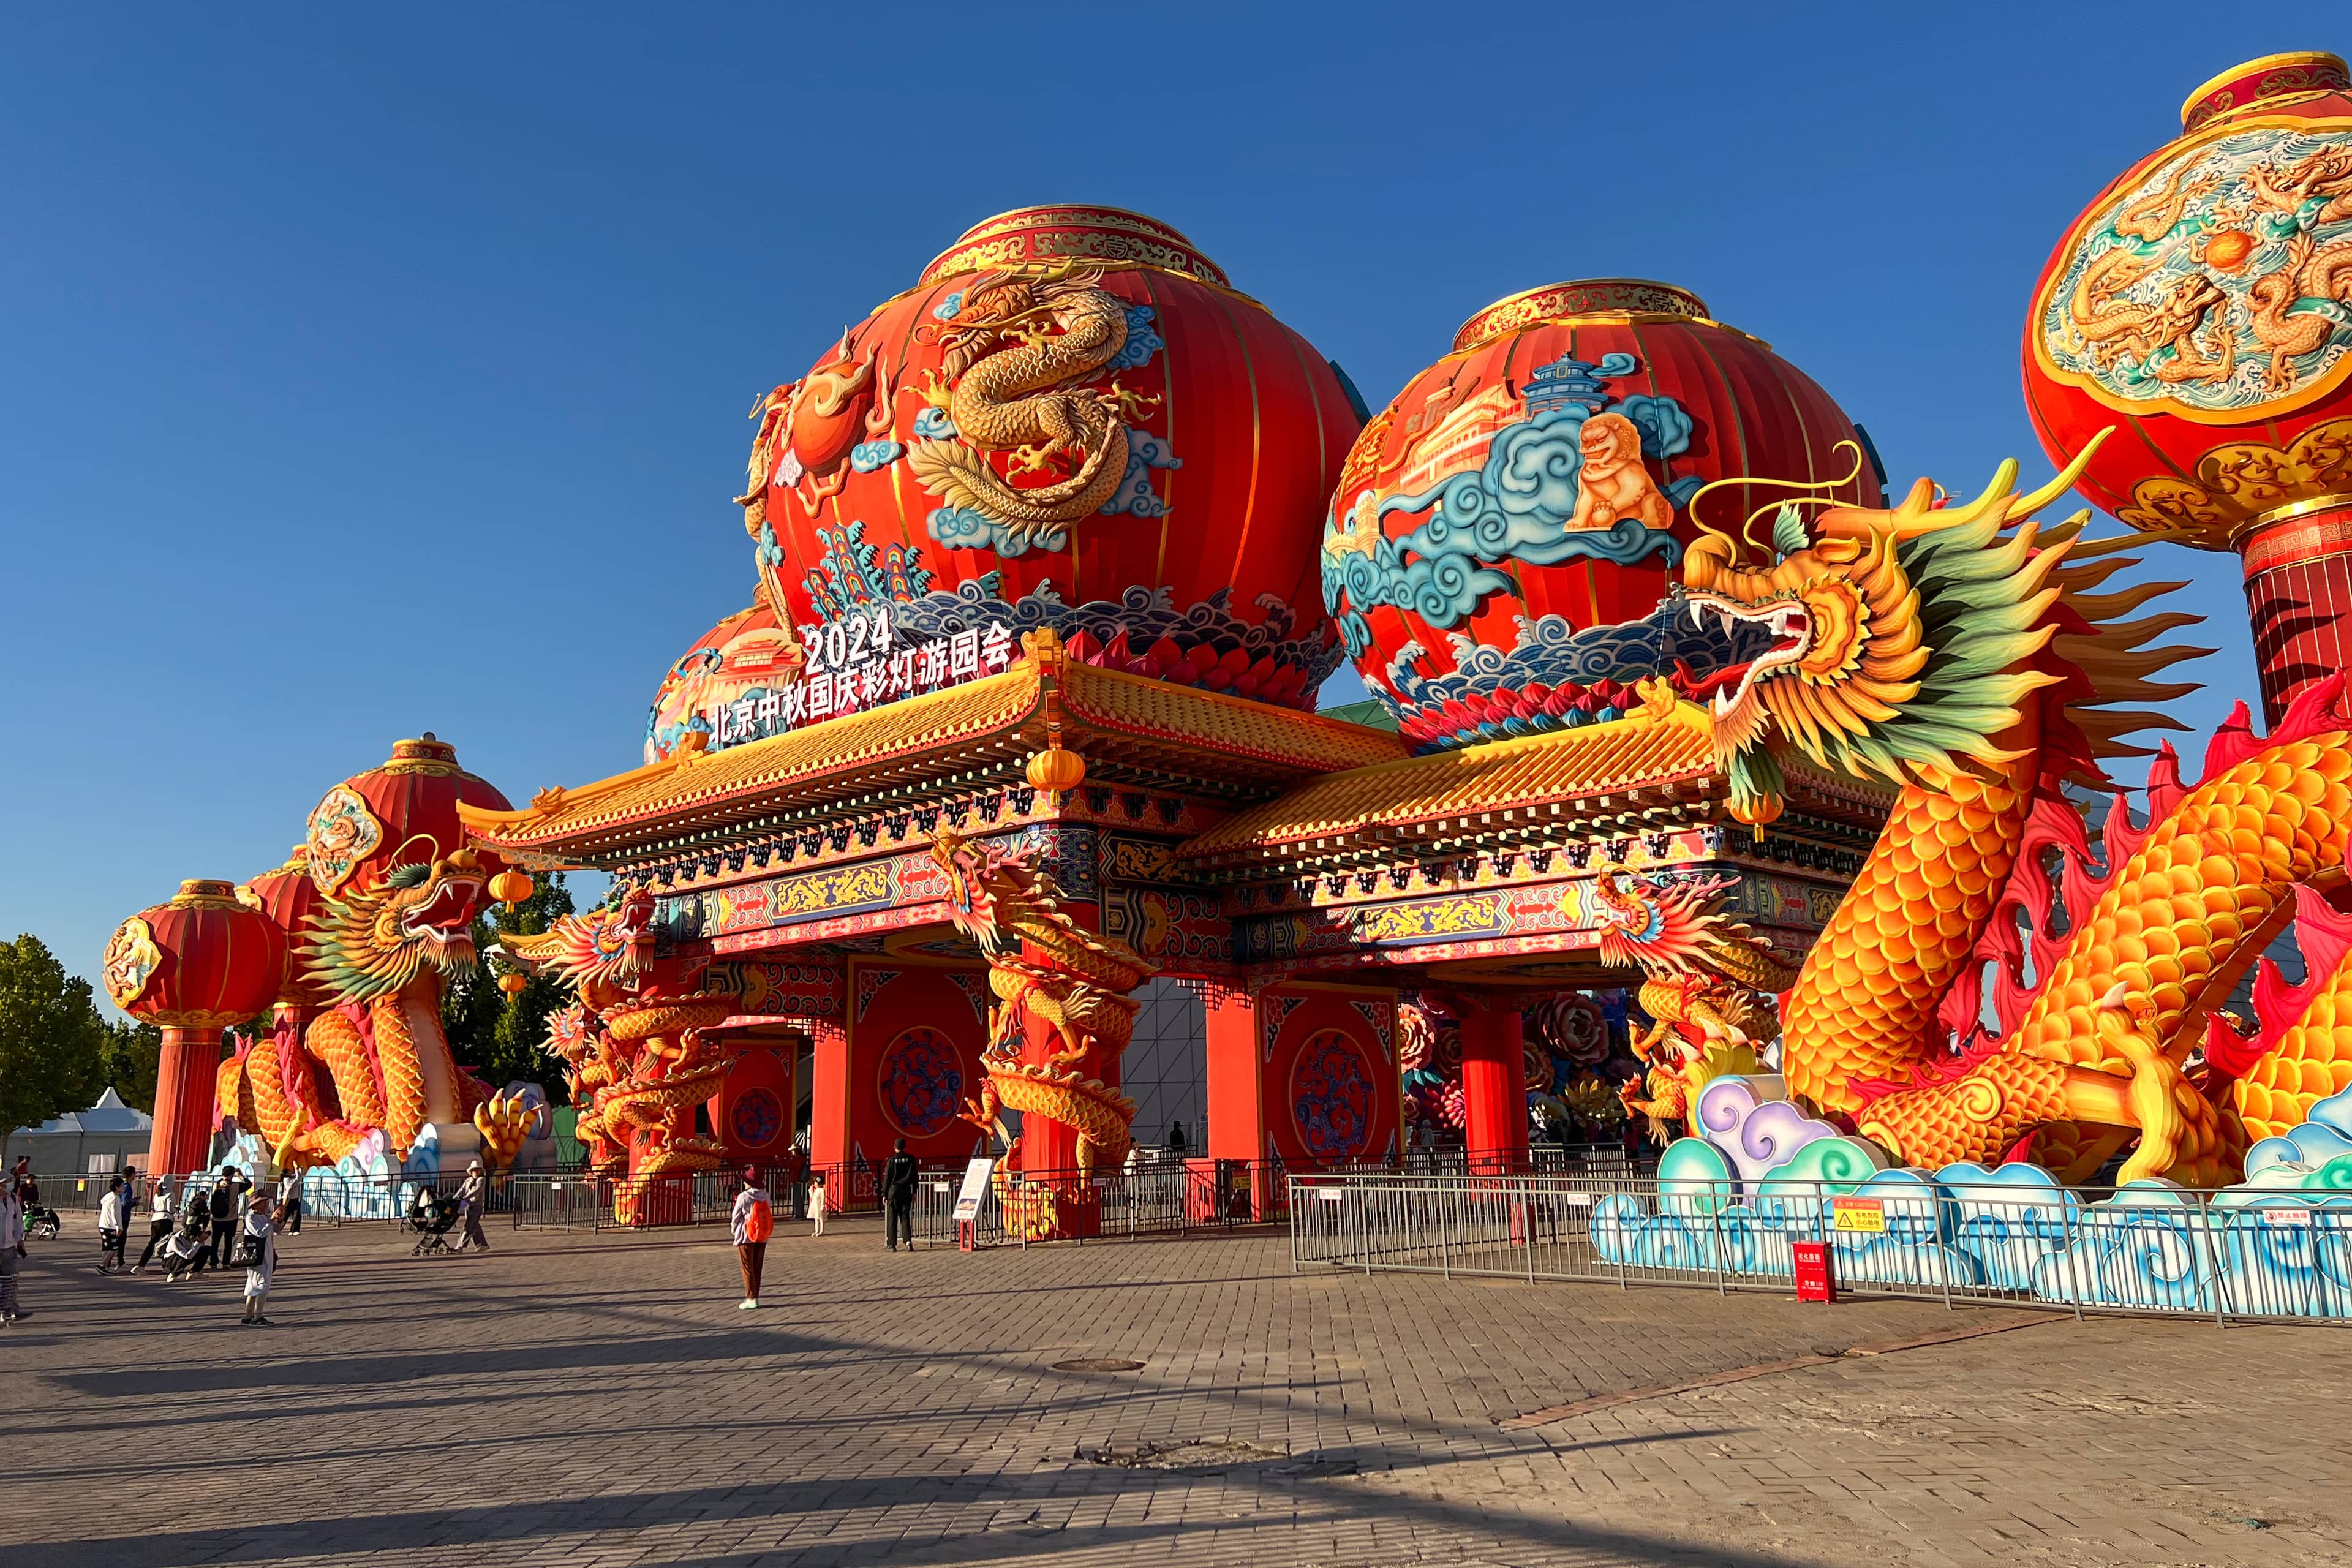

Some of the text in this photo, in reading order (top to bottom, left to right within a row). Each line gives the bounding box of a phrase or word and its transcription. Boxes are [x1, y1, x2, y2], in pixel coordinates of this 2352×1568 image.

[709, 620, 1012, 744] 北京中秋国庆彩灯游园会
[805, 609, 894, 675] 2024
